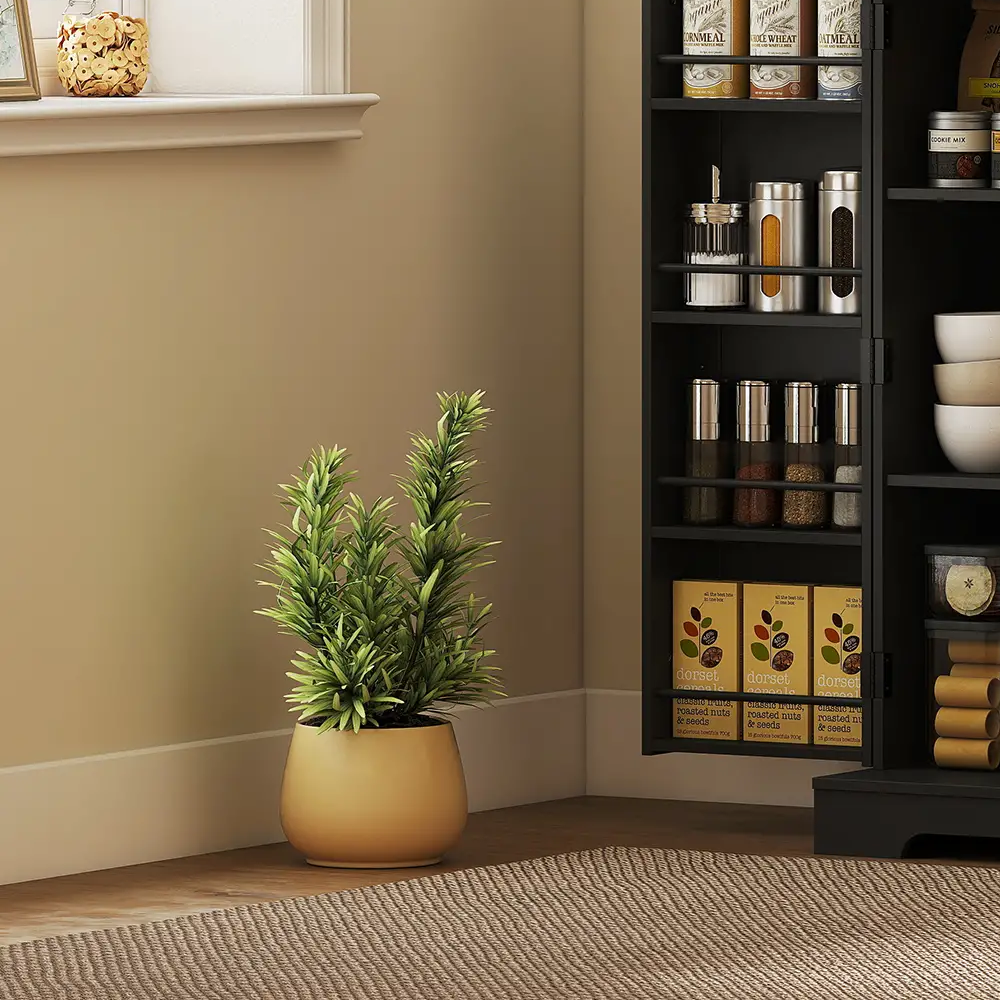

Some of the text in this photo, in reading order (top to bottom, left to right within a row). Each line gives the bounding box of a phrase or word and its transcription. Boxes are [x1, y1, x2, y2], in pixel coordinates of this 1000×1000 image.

[768, 34, 797, 43] WHEAT
[931, 136, 951, 144] COOKIE
[676, 668, 720, 682] dorset
[747, 671, 790, 685] dorset
[817, 674, 861, 688] dorset
[676, 707, 731, 717] roasted nuts
[747, 711, 802, 720] roasted nuts
[676, 716, 710, 726] & seeds
[818, 714, 850, 723] roasted
[747, 720, 781, 729] & seeds
[817, 723, 851, 733] & seeds
